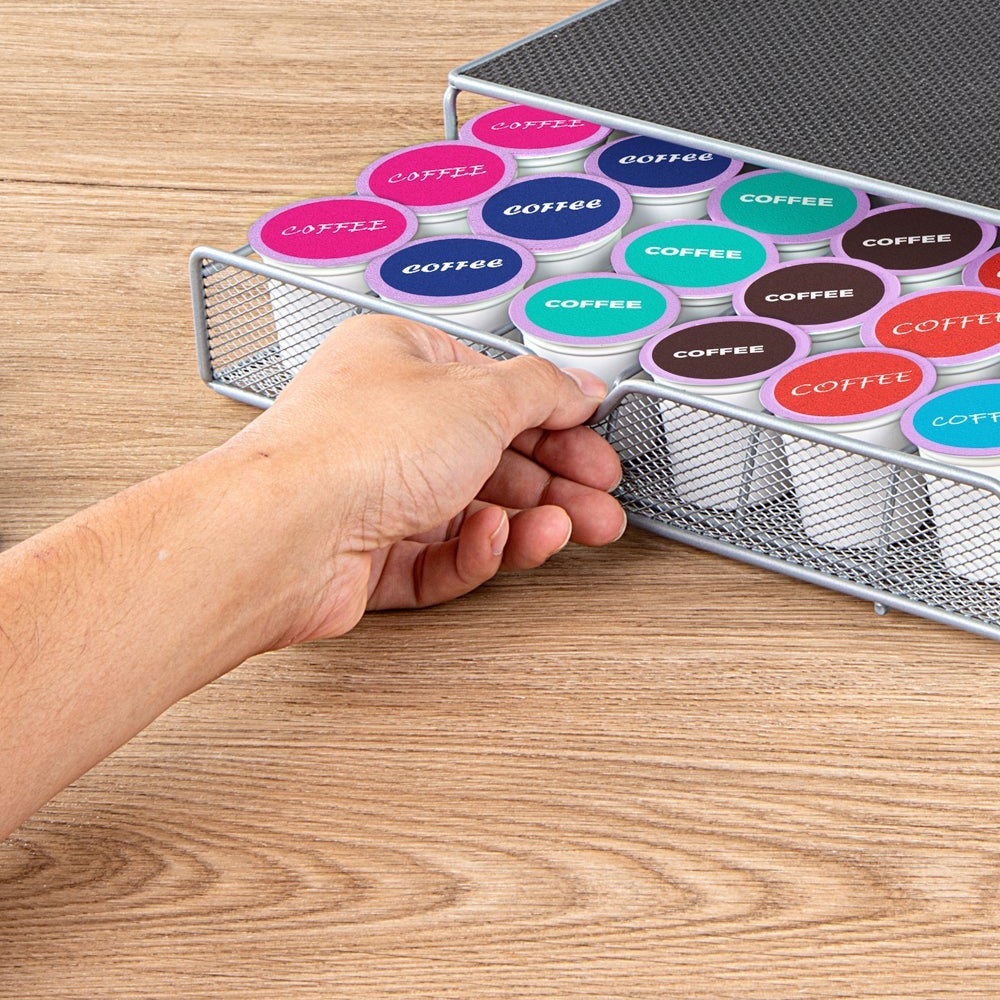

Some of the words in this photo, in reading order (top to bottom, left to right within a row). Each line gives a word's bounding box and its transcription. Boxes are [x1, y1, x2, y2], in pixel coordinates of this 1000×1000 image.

[490, 119, 585, 130] COFFEE
[388, 164, 487, 184] COFFEE
[739, 193, 834, 207] COFFEE
[281, 219, 387, 236] COFFEE
[862, 233, 952, 247] COFFEE
[644, 246, 742, 260] COFFEE
[764, 288, 854, 303] COFFEE
[544, 299, 642, 309] COFFEE
[673, 345, 765, 359] COFFEE
[791, 370, 912, 396] COFFEE
